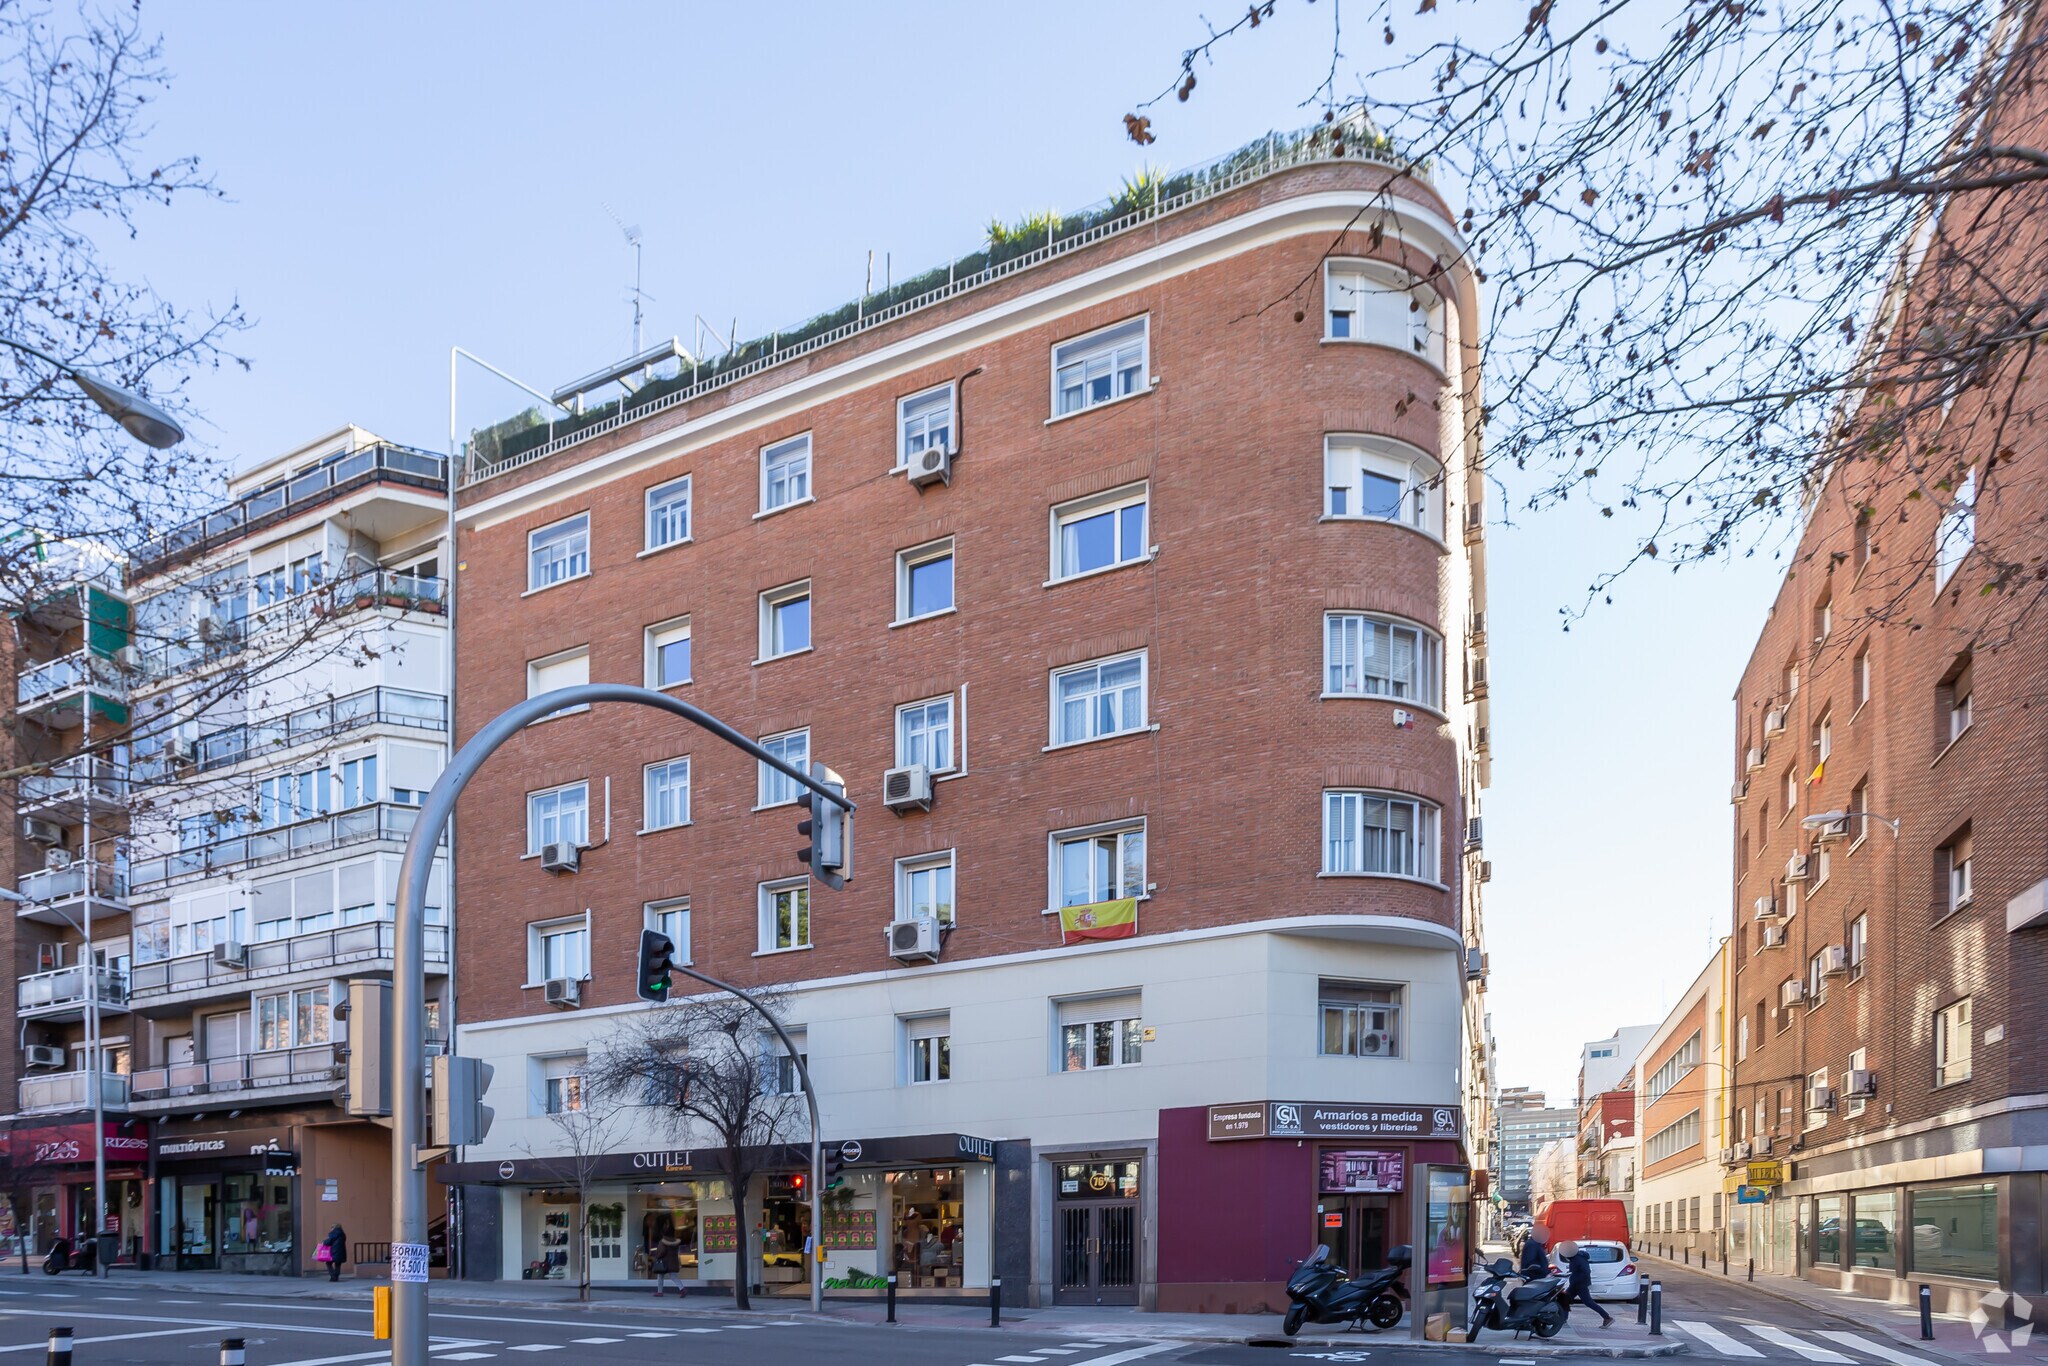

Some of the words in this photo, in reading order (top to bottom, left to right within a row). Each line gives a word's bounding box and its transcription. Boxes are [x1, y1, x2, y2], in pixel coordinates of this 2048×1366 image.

[1213, 1113, 1238, 1122] Empresa
[1238, 1111, 1261, 1120] fundada
[1313, 1109, 1369, 1121] Armarios
[1371, 1112, 1378, 1121] a
[1381, 1112, 1423, 1122] medida
[1234, 1121, 1249, 1130] 1.979
[1319, 1123, 1370, 1131] vestidores
[1372, 1124, 1378, 1132] y
[1380, 1123, 1418, 1132] librerías
[959, 1135, 994, 1157] OUTLET
[633, 1150, 693, 1168] OUTLET
[392, 1246, 427, 1257] EFORMAS
